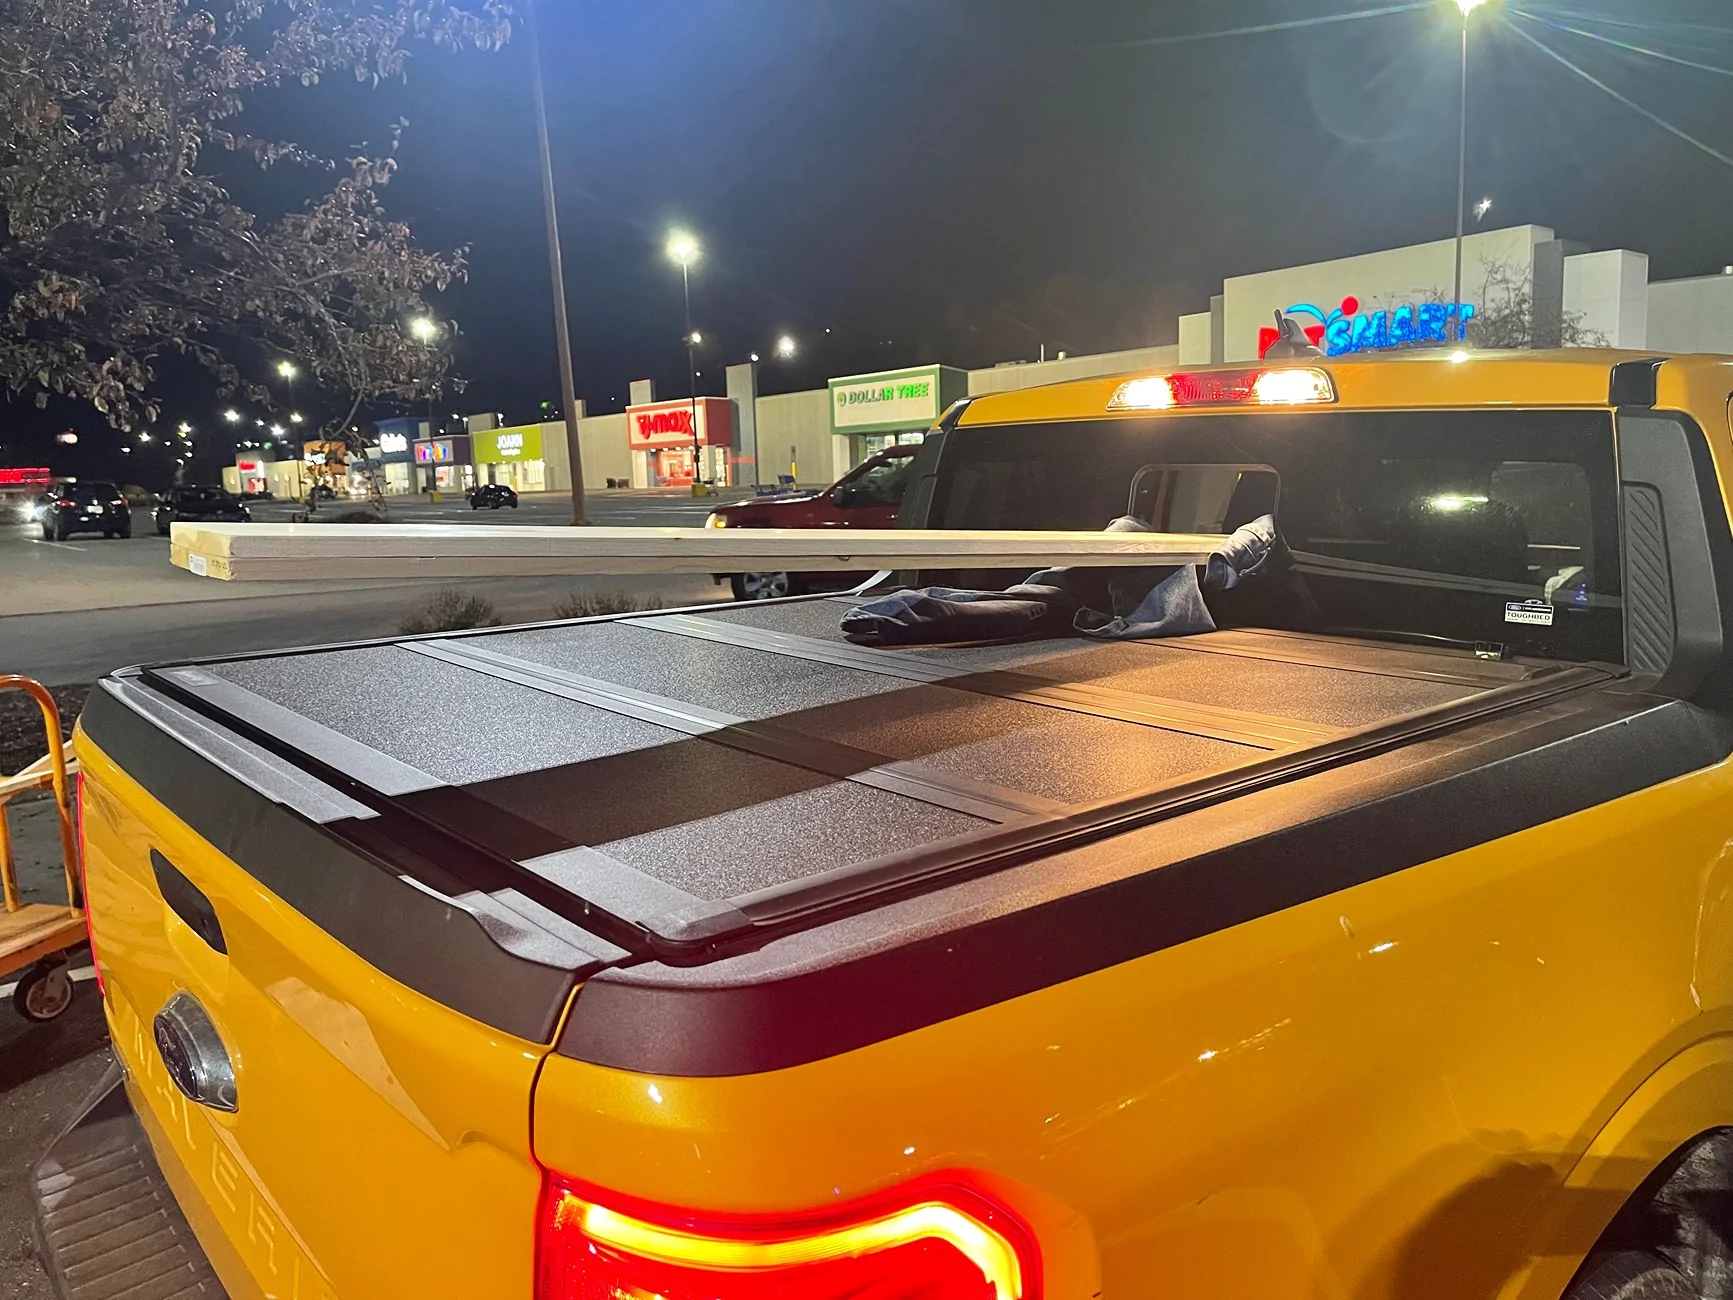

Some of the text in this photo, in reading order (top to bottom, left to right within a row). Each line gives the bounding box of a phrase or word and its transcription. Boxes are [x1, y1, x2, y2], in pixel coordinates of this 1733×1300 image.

[849, 382, 930, 404] DOLLAR TREE
[496, 433, 524, 449] JOANN
